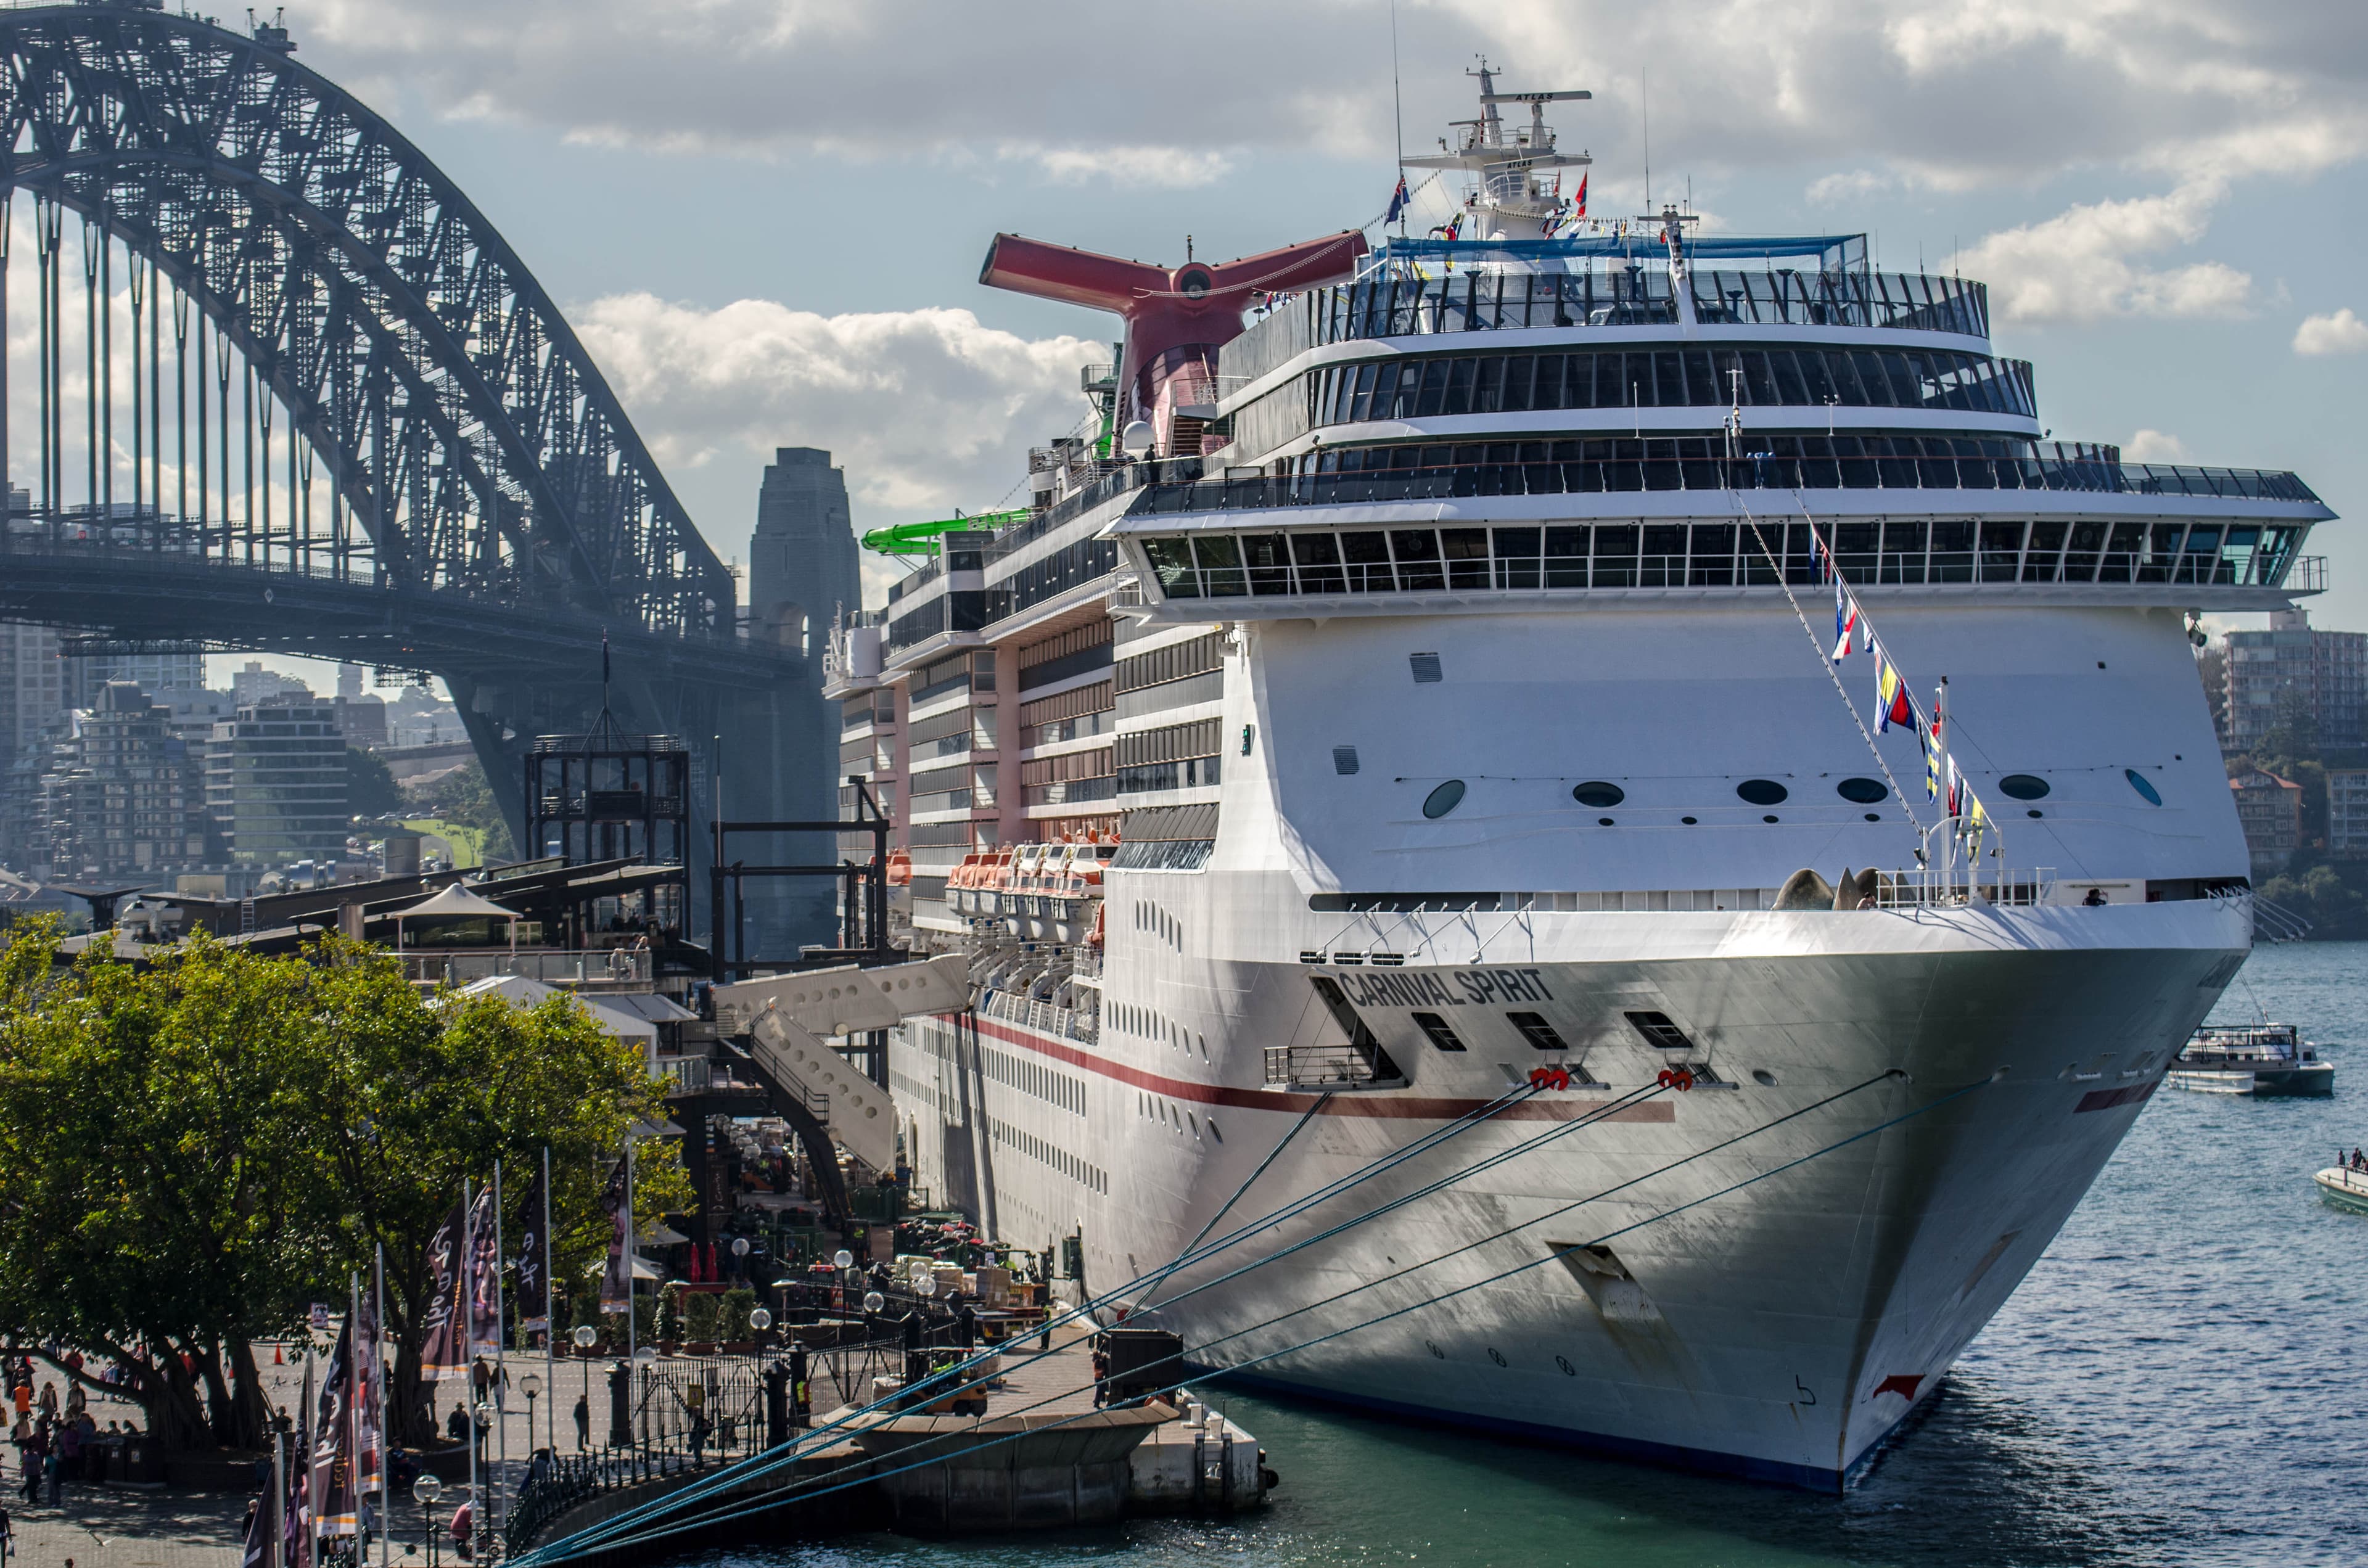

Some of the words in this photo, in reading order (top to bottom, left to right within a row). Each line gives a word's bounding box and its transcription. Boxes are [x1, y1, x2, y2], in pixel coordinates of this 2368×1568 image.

[1507, 160, 1532, 168] ATLAS
[1339, 972, 1466, 1006] CARNIVAL
[1454, 969, 1554, 1004] SPIRIT
